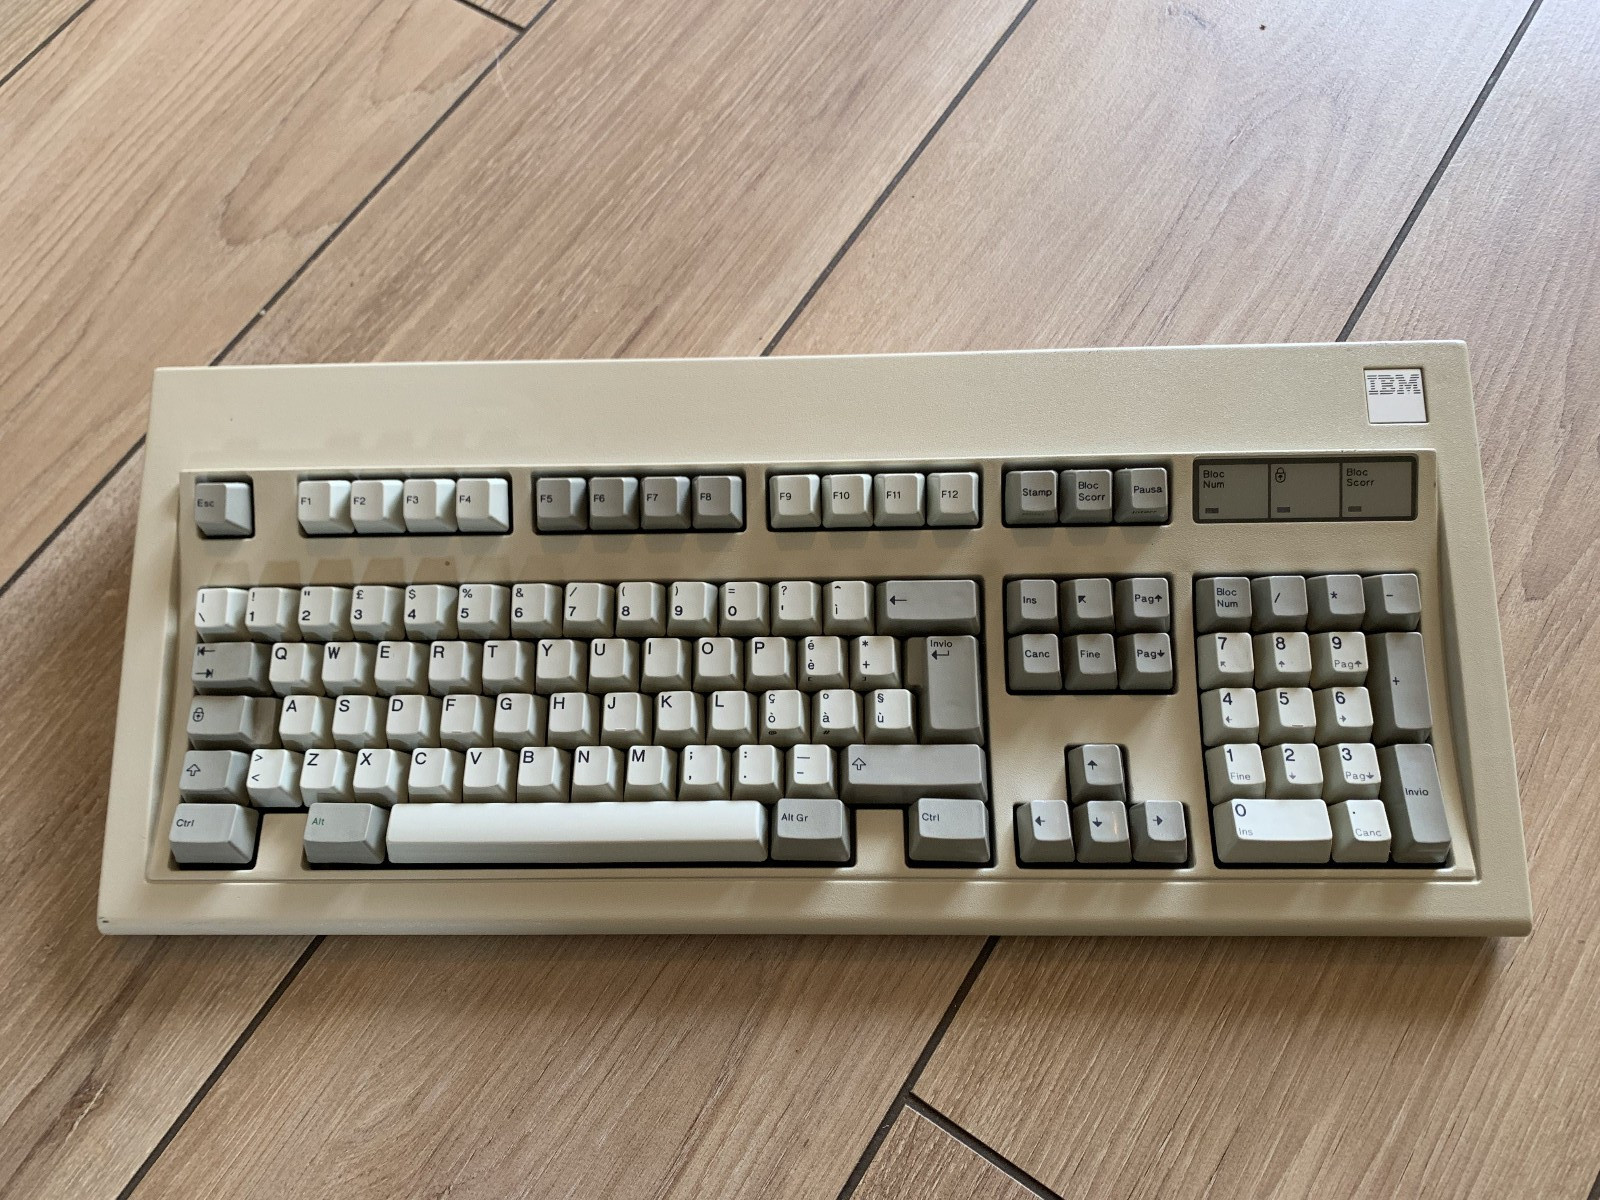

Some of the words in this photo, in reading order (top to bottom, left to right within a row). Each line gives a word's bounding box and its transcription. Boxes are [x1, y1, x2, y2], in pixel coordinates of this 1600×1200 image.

[1366, 373, 1422, 396] IBM
[1203, 469, 1224, 478] Bloc
[1346, 468, 1368, 478] Bloc
[1078, 481, 1098, 489] Bloc
[1203, 480, 1224, 488] Num
[647, 493, 658, 501] F7
[700, 493, 711, 501] F8
[780, 492, 791, 500] F9
[887, 491, 900, 499] F11
[942, 490, 958, 498] F12
[1023, 488, 1052, 497] Stamp
[1079, 493, 1105, 501] Scorr
[196, 499, 214, 507] Esc
[301, 497, 311, 505] F1
[354, 497, 366, 505] F2
[407, 496, 418, 504] F3
[459, 495, 471, 503] F4
[540, 495, 553, 503] F5
[594, 494, 605, 502] F6
[356, 590, 363, 599] £
[409, 589, 416, 600] $
[462, 589, 472, 598] %
[516, 588, 523, 597] &
[569, 587, 577, 597] /
[781, 586, 787, 595] ?
[1217, 588, 1237, 596] Bloc
[1023, 596, 1037, 604] Ins
[1274, 593, 1280, 603] /
[250, 611, 254, 621] 1
[302, 610, 310, 621] 2
[354, 609, 362, 620] 3
[408, 609, 416, 619] 4
[461, 608, 469, 618] 5
[515, 607, 523, 618] 6
[569, 606, 576, 616] 7
[622, 606, 630, 616] 8
[675, 606, 683, 616] 9
[755, 641, 765, 654] P
[808, 640, 814, 650] é
[1218, 637, 1227, 650] 7
[1276, 637, 1286, 650] 8
[1332, 636, 1342, 649] 9
[328, 647, 340, 659] W
[380, 646, 390, 658] E
[433, 646, 444, 658] R
[488, 645, 498, 658] T
[542, 644, 552, 656] Y
[595, 643, 605, 656] U
[648, 642, 652, 654] I
[702, 642, 713, 654] O
[275, 647, 287, 660] Q
[1025, 650, 1050, 658] Canc
[1080, 650, 1100, 659] Fine
[808, 659, 814, 670] è
[863, 661, 870, 669] +
[1393, 677, 1400, 685] +
[661, 695, 672, 708] K
[715, 695, 724, 707] L
[769, 694, 775, 703] ç
[877, 693, 884, 703] §
[1223, 692, 1232, 705] 4
[1280, 692, 1289, 705] 5
[1335, 691, 1345, 704] 6
[286, 700, 296, 712] A
[337, 698, 350, 712] S
[390, 698, 403, 711] D
[444, 698, 456, 711] F
[500, 697, 512, 710] G
[553, 697, 565, 709] H
[608, 697, 615, 709] J
[768, 713, 775, 723] ò
[823, 712, 830, 722] à
[878, 712, 884, 723] ù
[253, 753, 263, 761] >
[307, 753, 319, 766] Z
[360, 753, 372, 765] X
[415, 752, 426, 765] C
[471, 752, 482, 764] V
[523, 751, 534, 763] B
[578, 750, 589, 763] N
[632, 749, 645, 762] M
[1227, 749, 1233, 762] 1
[1285, 748, 1295, 761] 2
[1342, 748, 1352, 761] 3
[1230, 772, 1250, 780] Fine
[1405, 788, 1428, 796] Invio
[781, 813, 793, 821] Alt
[796, 814, 808, 822] Gr
[922, 813, 939, 821] Ctrl
[176, 819, 194, 827] Ctrl
[1239, 828, 1253, 836] Ins
[1354, 828, 1382, 838] Canc
